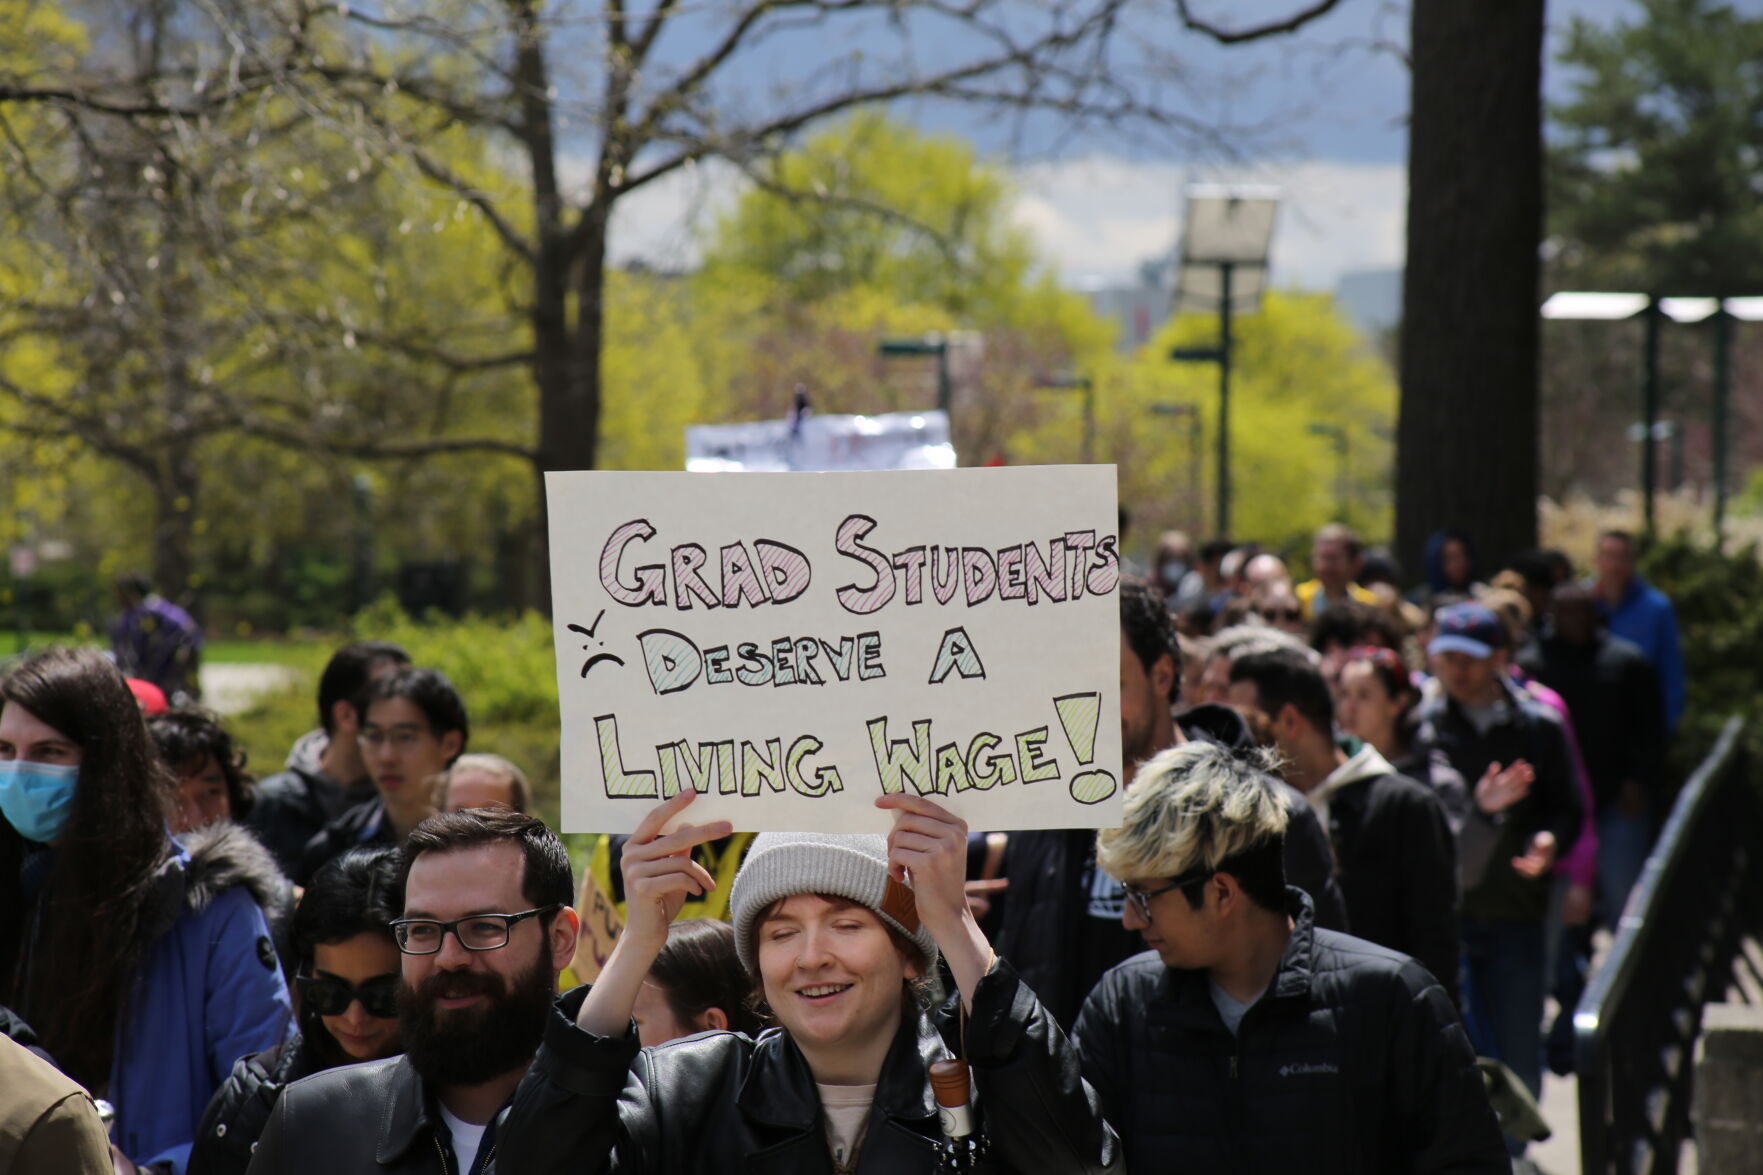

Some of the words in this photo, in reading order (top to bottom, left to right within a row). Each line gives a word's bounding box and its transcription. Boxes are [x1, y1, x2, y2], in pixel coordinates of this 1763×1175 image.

[600, 518, 811, 610] GRAD
[835, 514, 1120, 615] STUDENTS
[636, 628, 886, 695] DESERVE
[929, 626, 986, 684] A
[594, 713, 844, 800] LIVING
[866, 691, 1117, 805] WAGE!
[1289, 1062, 1339, 1073] Columbia
